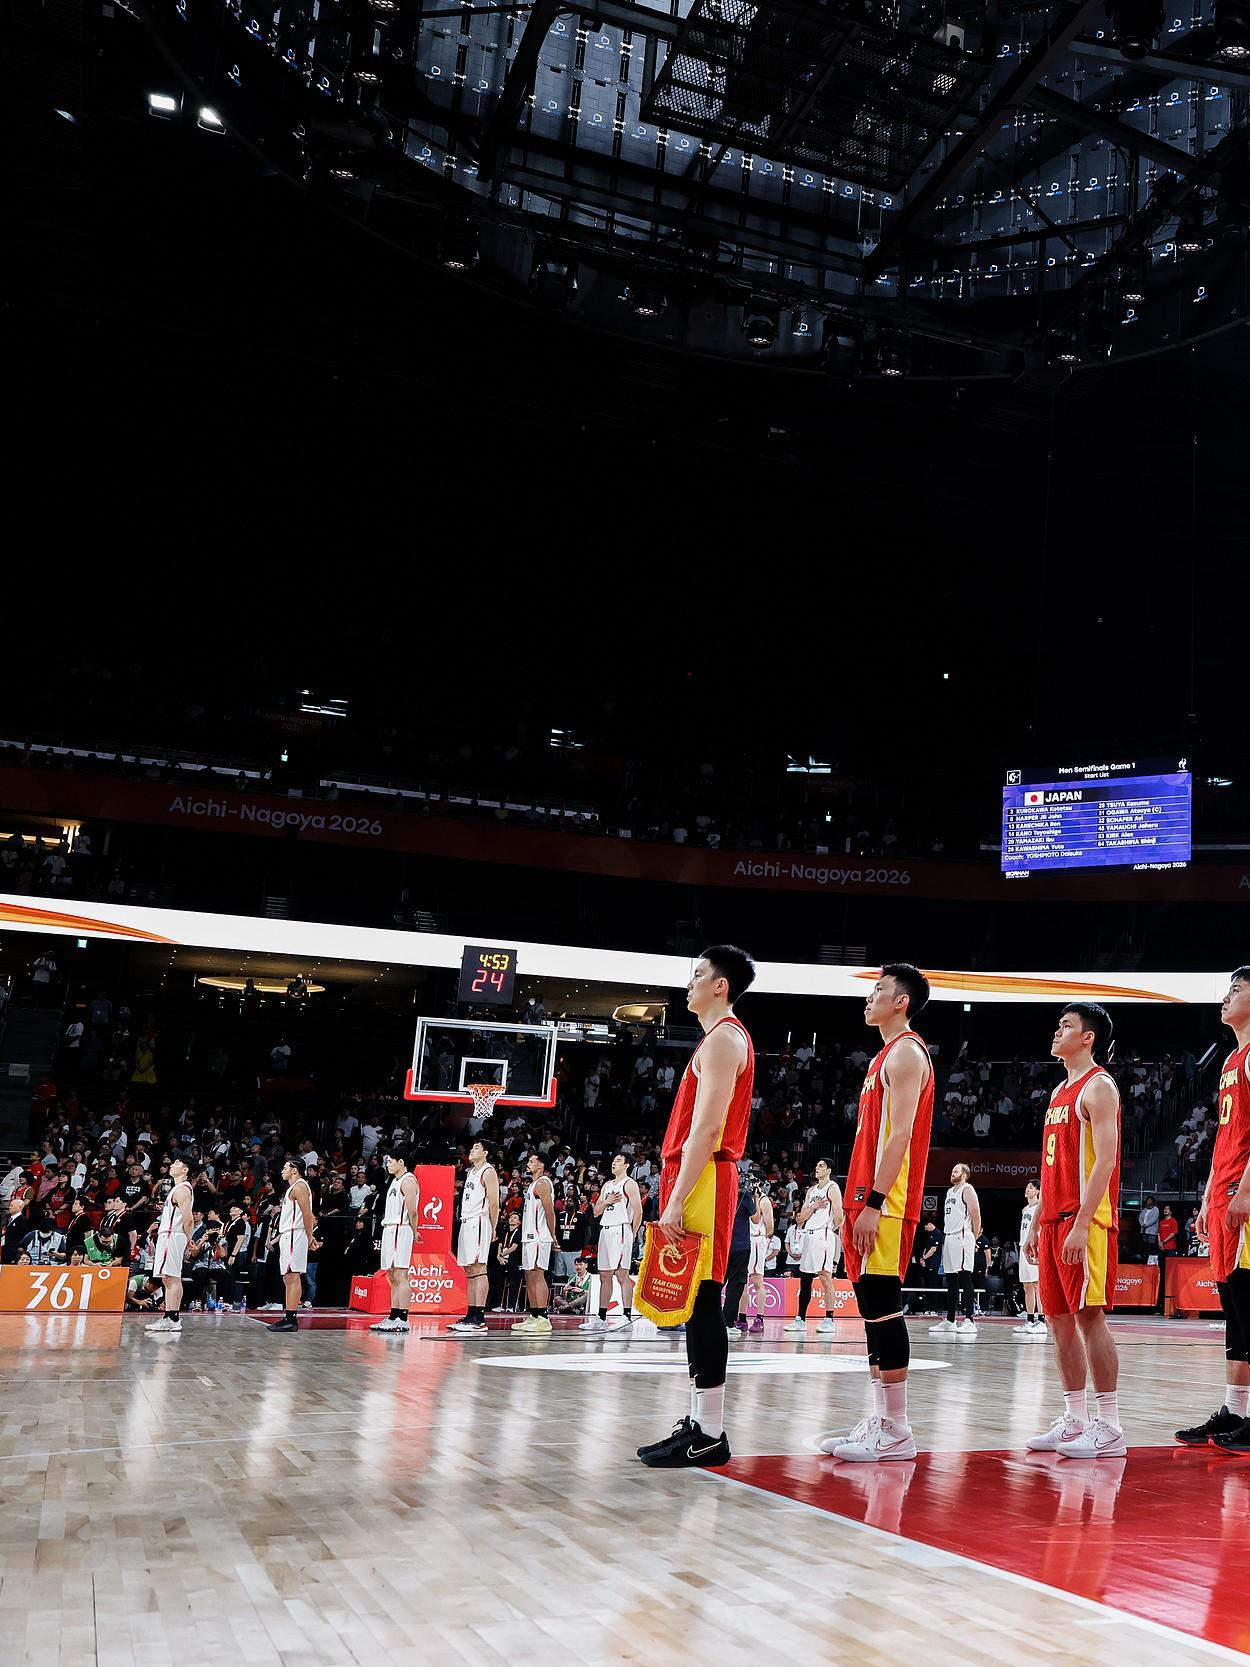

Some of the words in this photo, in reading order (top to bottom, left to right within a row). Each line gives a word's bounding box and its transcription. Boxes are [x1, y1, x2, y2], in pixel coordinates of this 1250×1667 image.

[1074, 764, 1109, 773] Semifinals
[1110, 763, 1131, 771] Game
[1045, 791, 1083, 803] JAPAN
[168, 796, 328, 831] Aichi-Nagoya
[327, 814, 384, 836] 2026
[734, 860, 863, 885] Aichi-Nagoya
[864, 868, 911, 885] 2026
[1133, 862, 1172, 870] Aichi-Nagoya
[480, 954, 510, 970] 4:53
[472, 969, 504, 992] 24
[970, 1162, 1038, 1176] ichi-Nagoya
[407, 1264, 449, 1277] Aichi-
[409, 1277, 454, 1291] agoya
[651, 1278, 666, 1287] TEAM
[666, 1281, 683, 1291] CHINA
[652, 1285, 679, 1296] BASKETBALL
[409, 1291, 443, 1304] 2026
[818, 1299, 845, 1308] 226
